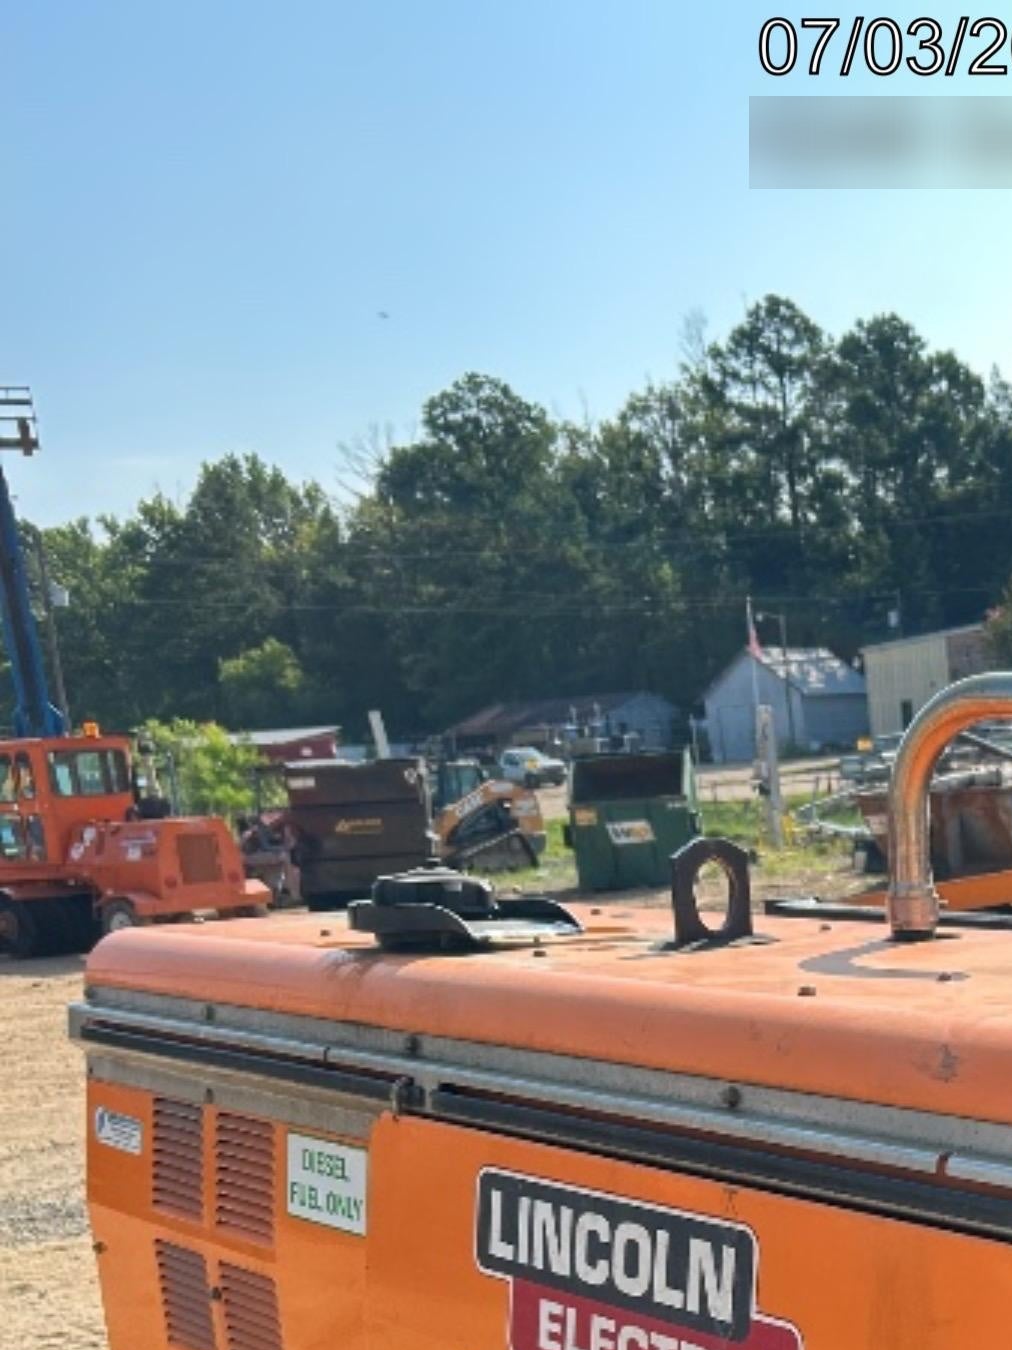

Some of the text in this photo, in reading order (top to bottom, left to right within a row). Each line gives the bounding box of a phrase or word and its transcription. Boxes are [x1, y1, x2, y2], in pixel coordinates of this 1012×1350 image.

[302, 1148, 349, 1182] DIESEL
[290, 1181, 364, 1223] FUEL ONLY
[488, 1189, 736, 1324] LINCOLN
